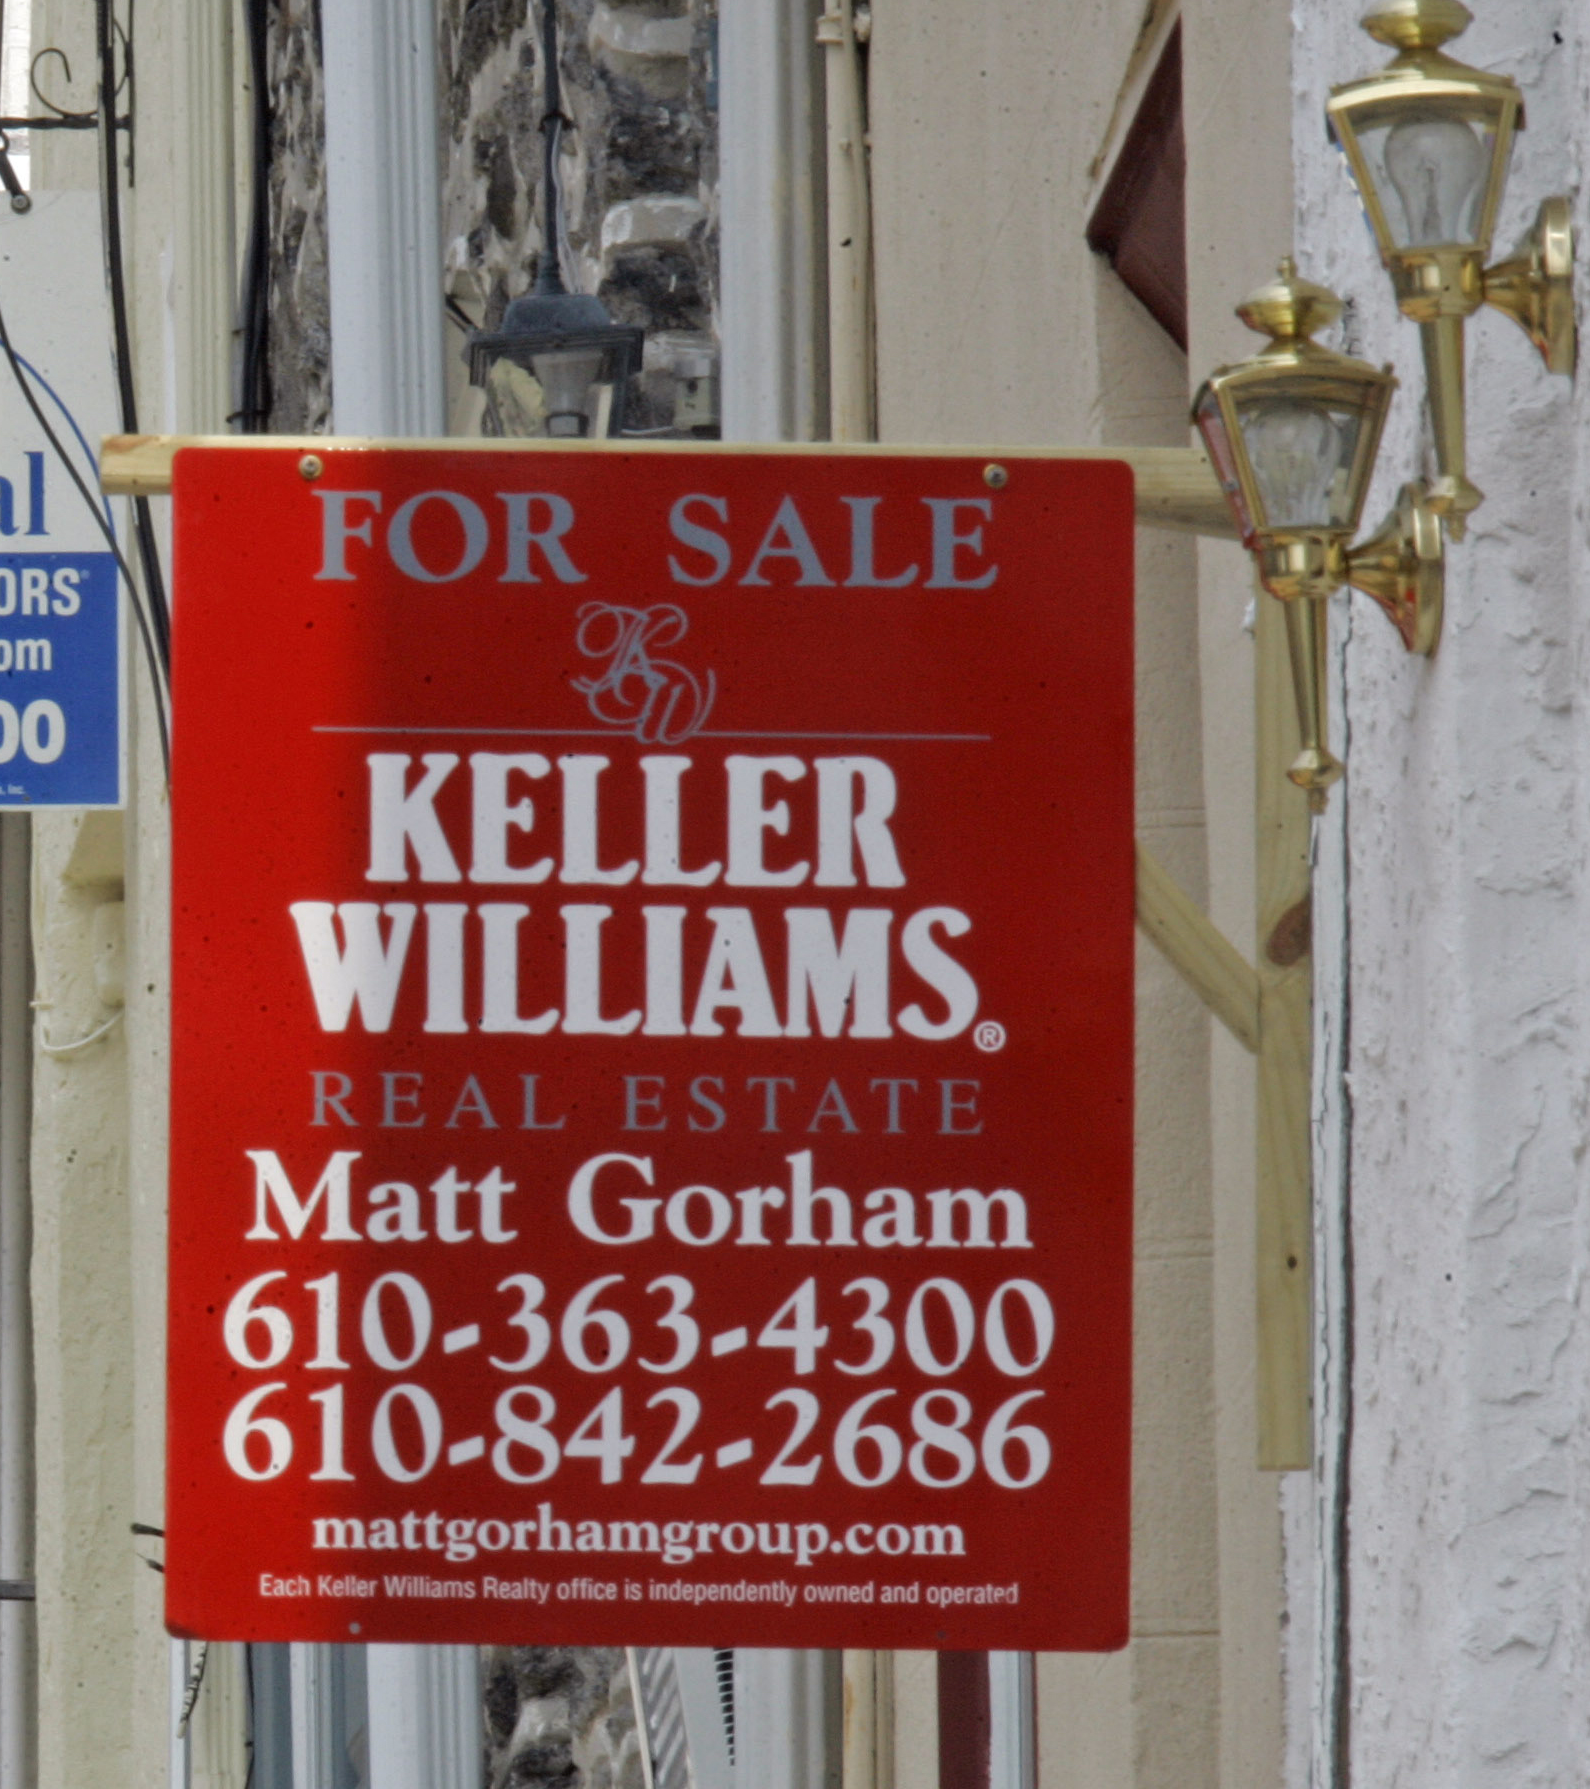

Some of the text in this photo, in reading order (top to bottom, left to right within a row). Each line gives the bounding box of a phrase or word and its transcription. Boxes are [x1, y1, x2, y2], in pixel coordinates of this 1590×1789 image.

[311, 489, 999, 590] FOR SALE
[365, 752, 906, 888] KELLER
[309, 1071, 982, 1134] REAL ESTATE
[245, 1150, 1033, 1248] Matt Gorham
[223, 1270, 1054, 1377] 610-363-4300
[223, 1384, 1050, 1489] 610-842-2686
[312, 1502, 966, 1566] mattgorhamgroup.com
[260, 1573, 1019, 1608] Each Keller Williams Realty office is independently owned and operated
